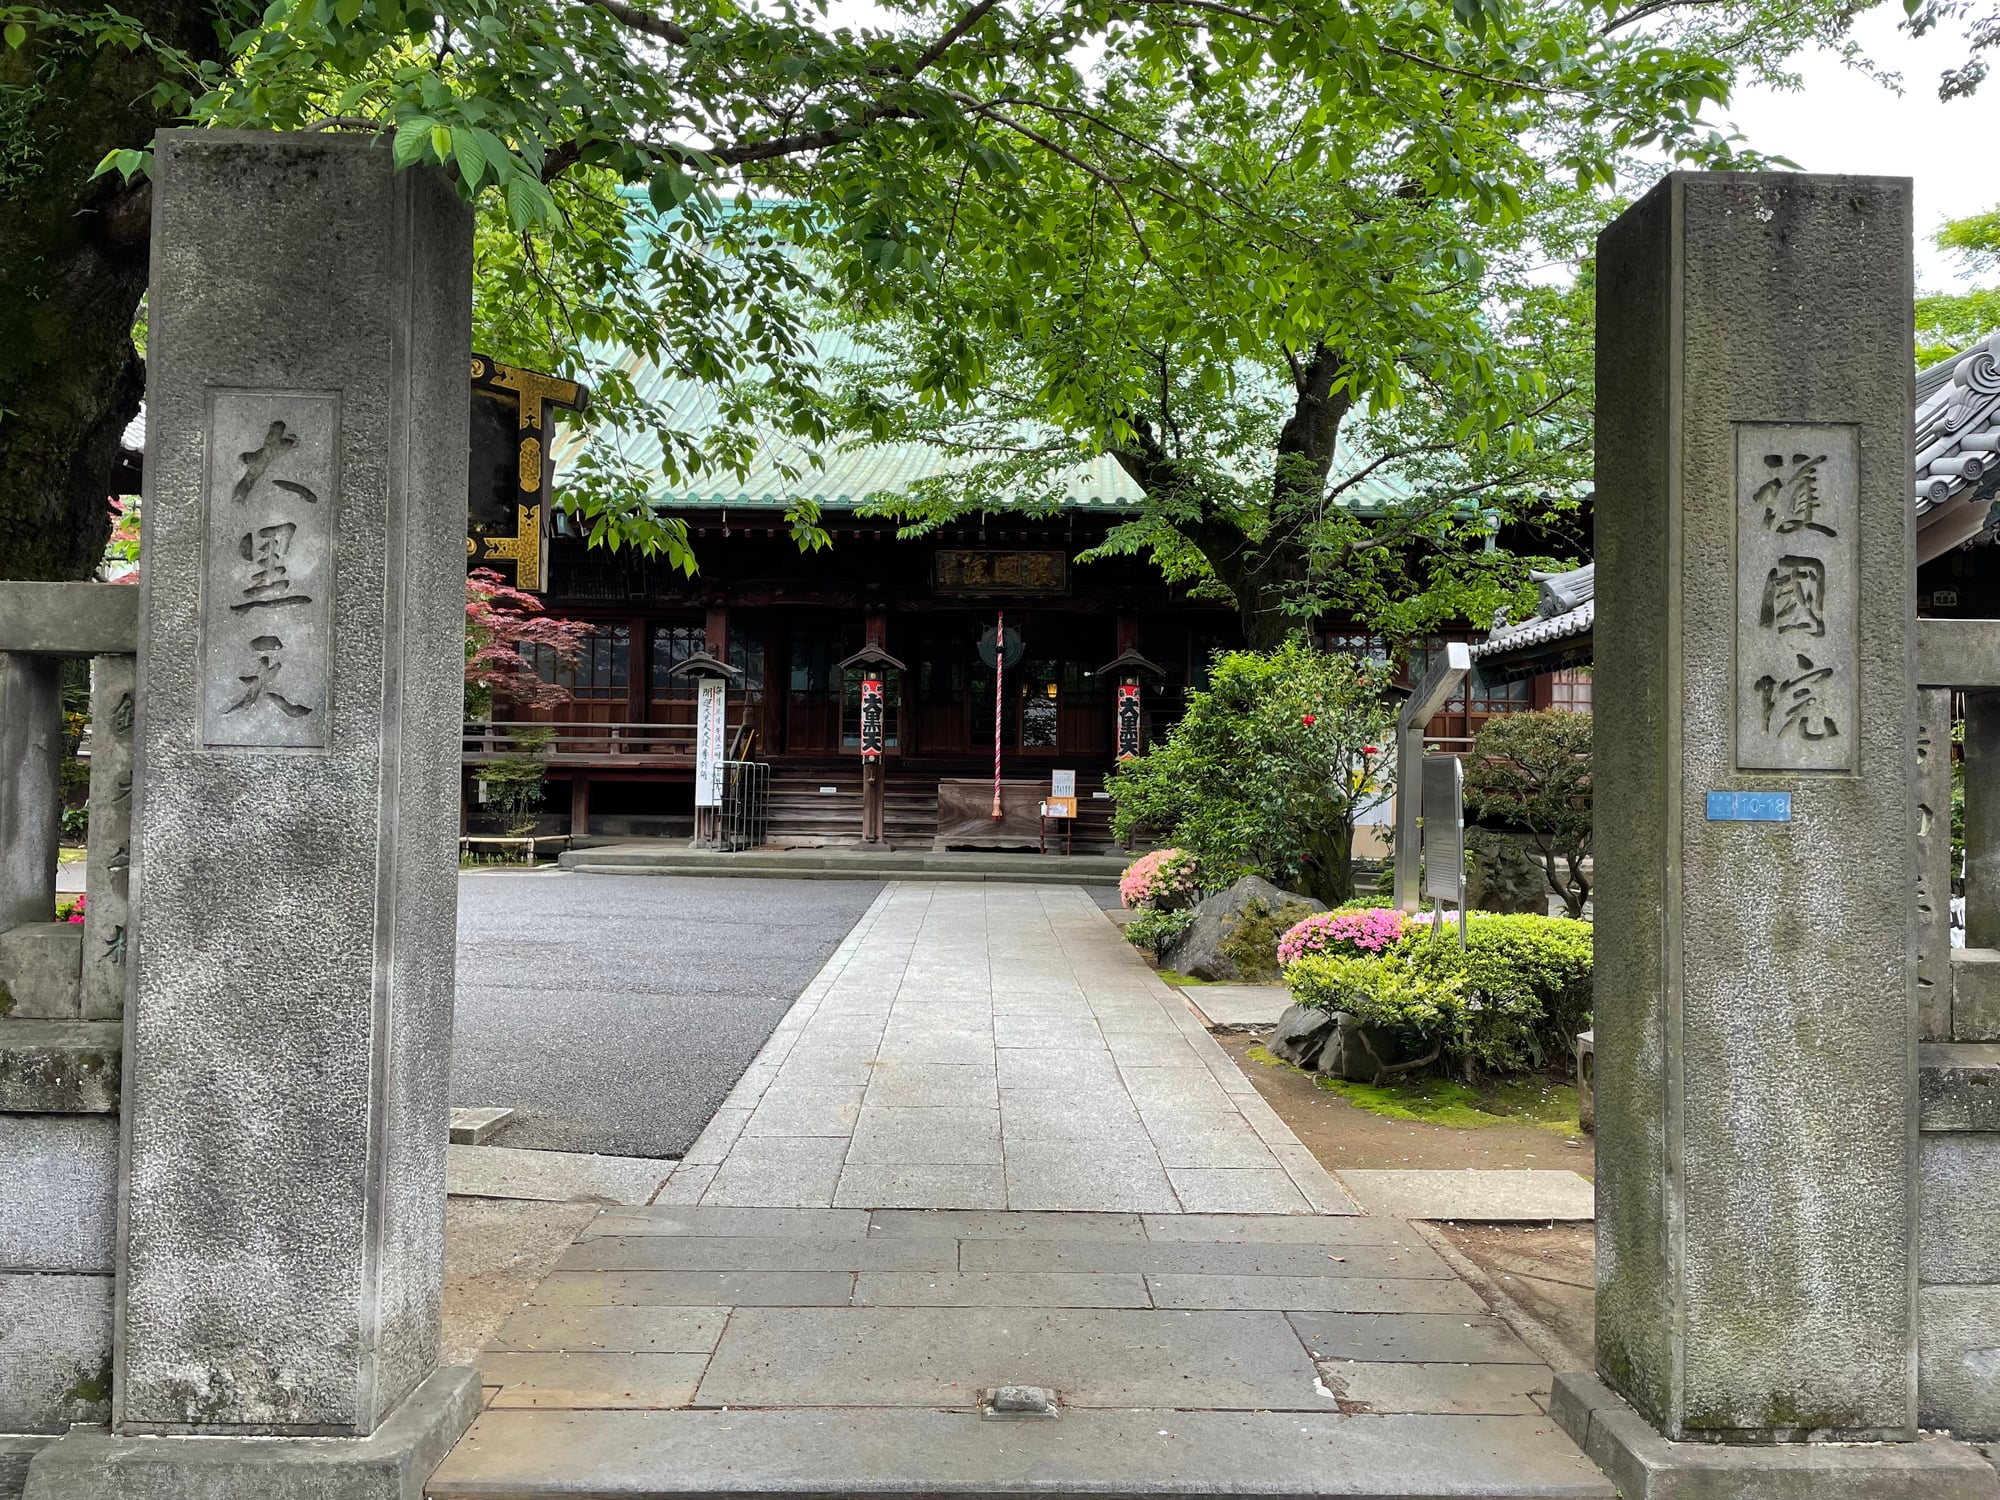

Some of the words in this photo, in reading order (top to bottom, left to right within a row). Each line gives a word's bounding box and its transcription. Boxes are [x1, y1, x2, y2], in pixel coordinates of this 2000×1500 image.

[1752, 453, 1838, 741] 護國院
[1742, 798, 1785, 815] 10-18
